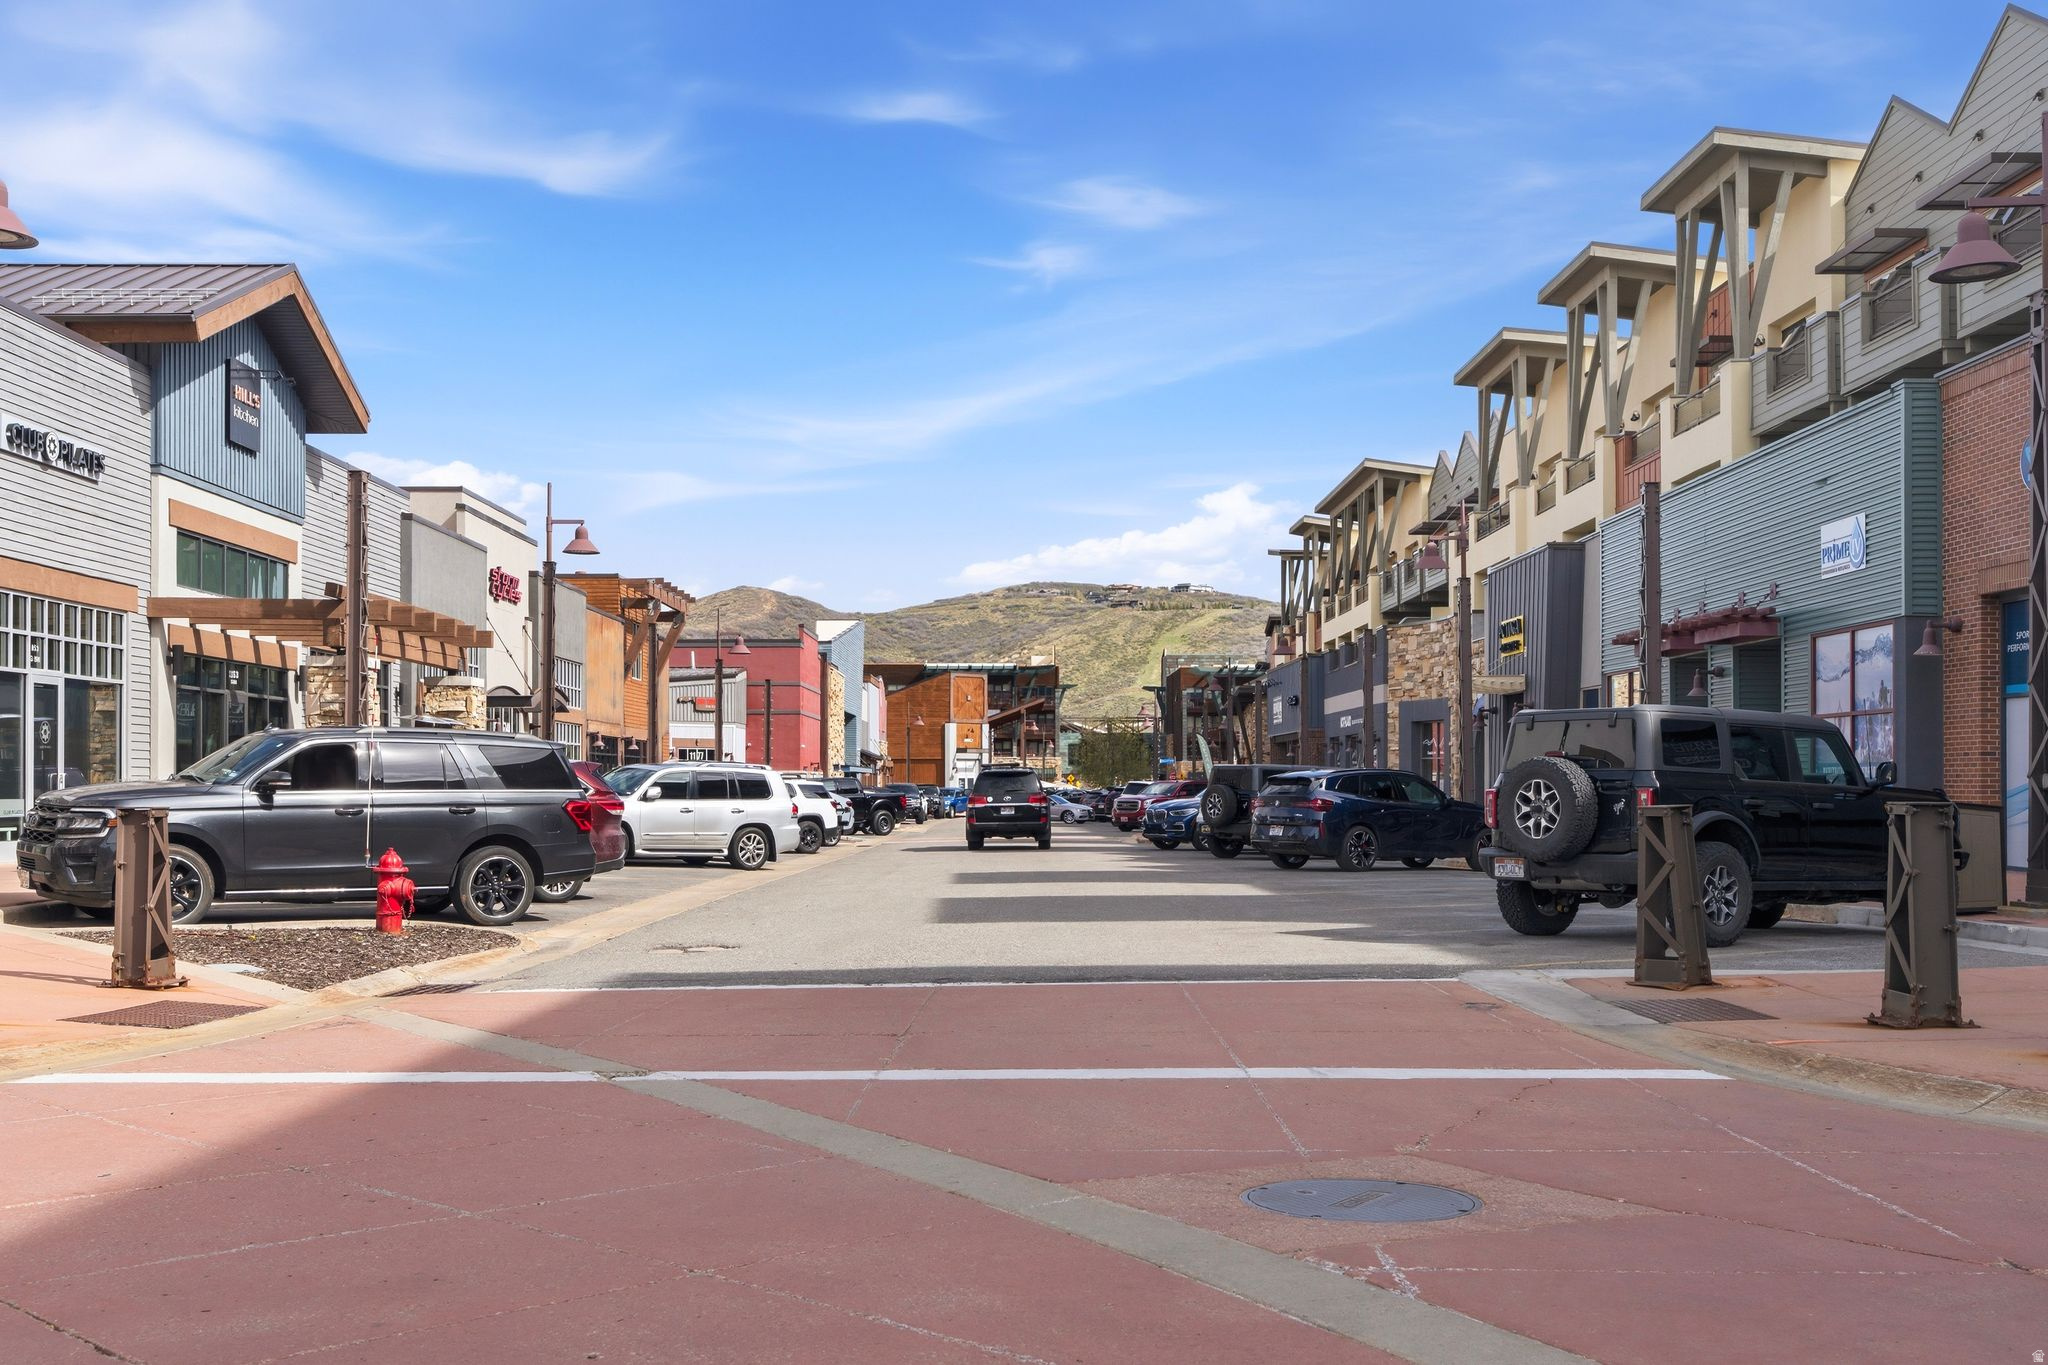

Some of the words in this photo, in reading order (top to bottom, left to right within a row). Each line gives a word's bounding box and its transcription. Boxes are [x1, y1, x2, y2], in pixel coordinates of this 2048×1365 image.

[234, 384, 260, 409] HILL'S
[233, 403, 259, 427] kitchen
[8, 423, 45, 453] CLUB
[60, 440, 106, 474] PILATES
[1822, 540, 1850, 564] PRIME
[490, 567, 519, 590] storm
